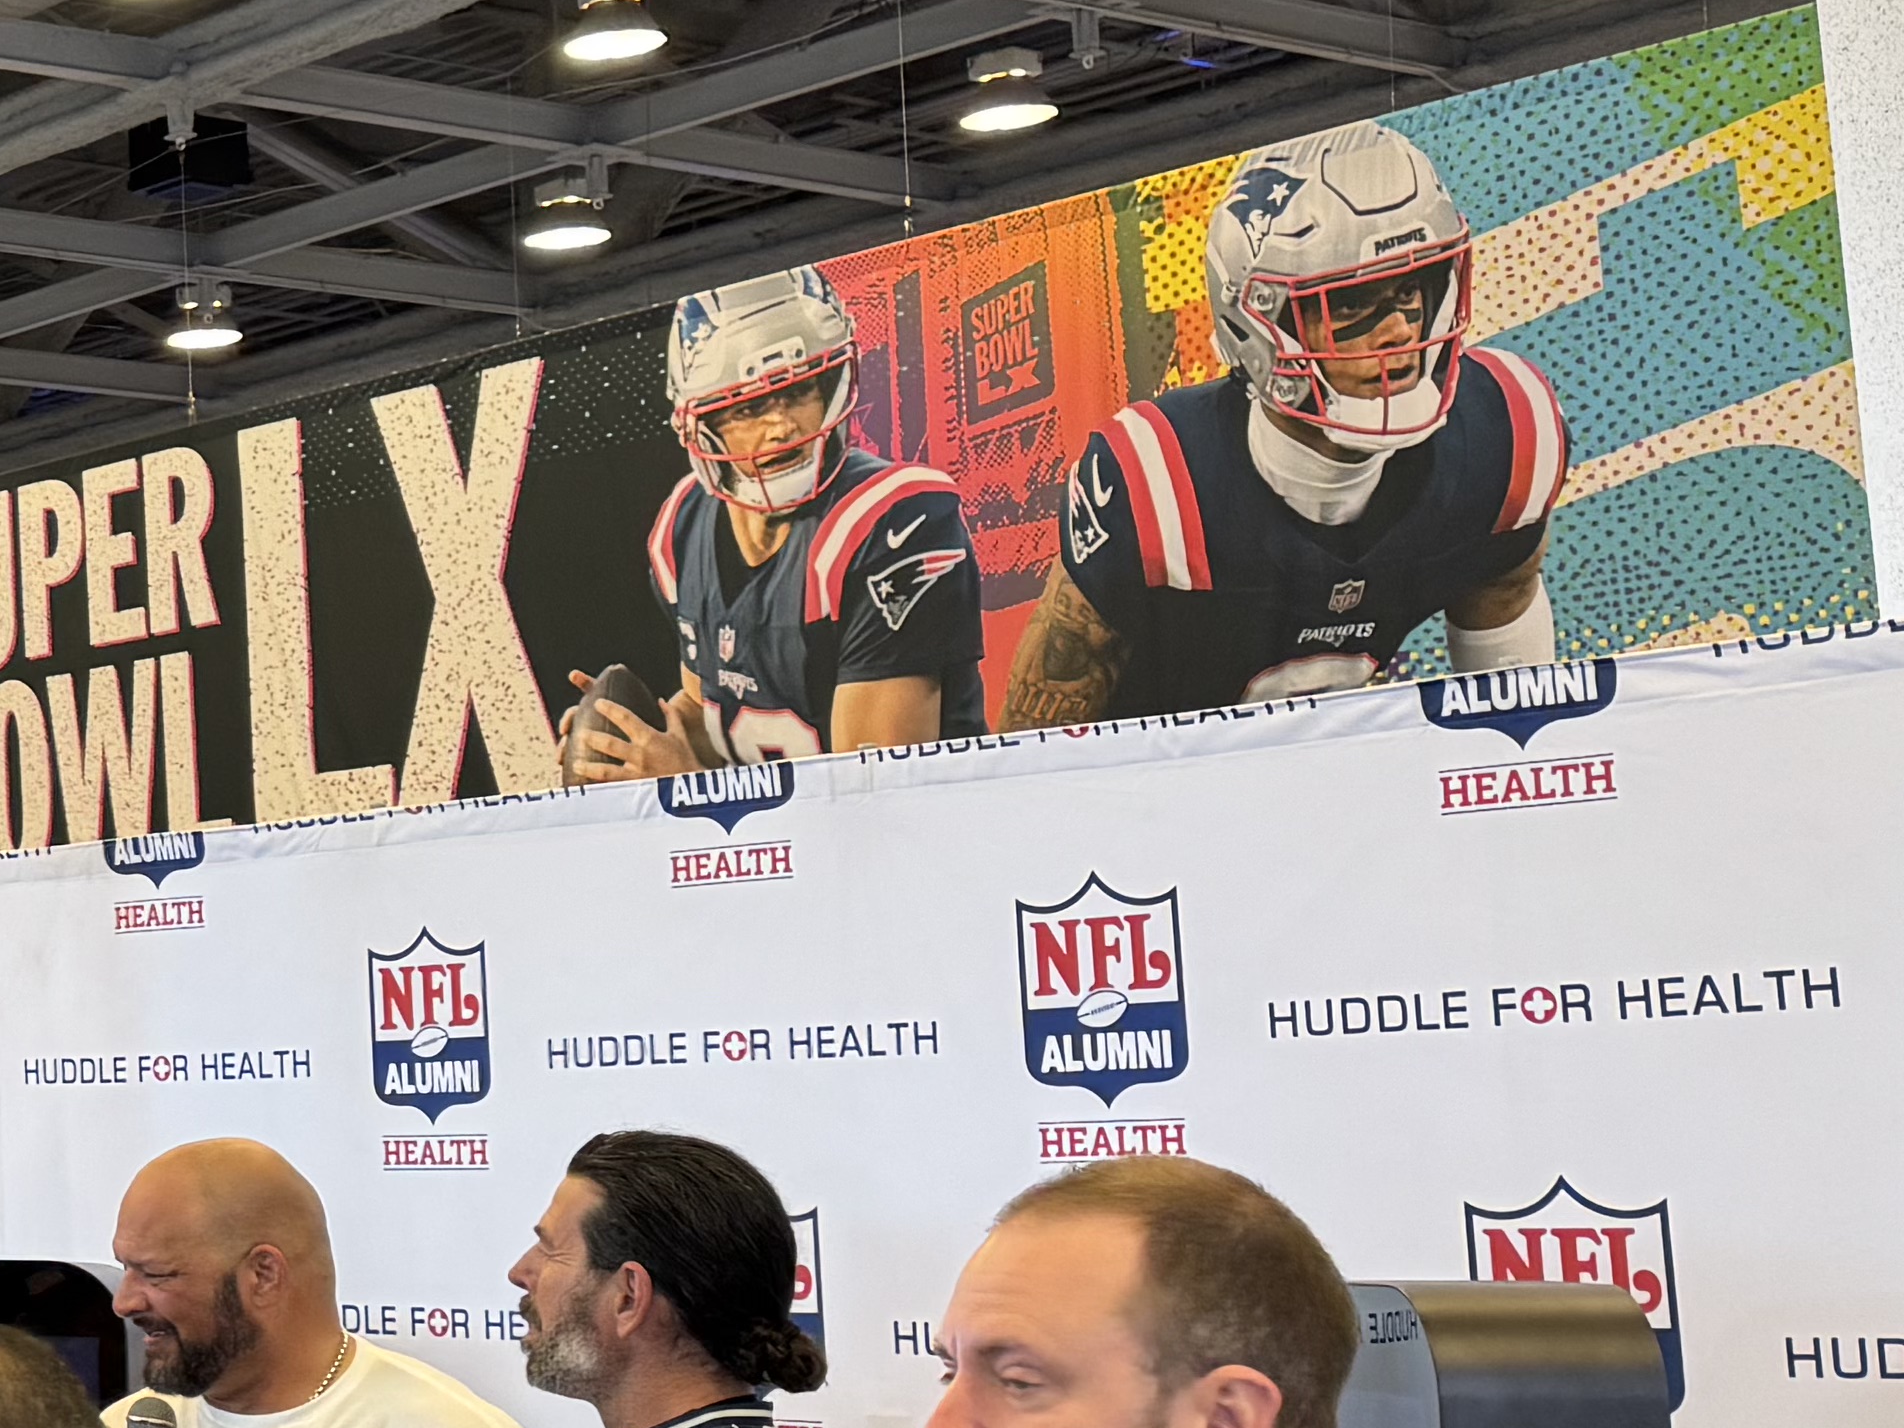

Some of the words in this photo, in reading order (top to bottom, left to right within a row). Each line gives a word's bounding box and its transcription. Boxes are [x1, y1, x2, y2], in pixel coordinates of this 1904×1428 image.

[971, 280, 1036, 341] SUPER
[975, 318, 1039, 379] BOWL
[977, 358, 1041, 406] LX
[237, 356, 565, 825] LX
[1440, 660, 1599, 718] ALUMNI
[671, 763, 784, 809] ALUMNI
[1440, 759, 1618, 810] HEALTH
[113, 831, 198, 866] ALUMNI
[670, 847, 794, 884] HEALTH
[114, 898, 206, 930] HEALTH
[1029, 912, 1172, 998] NFL
[376, 961, 481, 1033] NFL
[1268, 990, 1469, 1040] HUDDLE
[1492, 981, 1592, 1028] FOR
[1617, 966, 1842, 1021] HEALTH
[23, 1056, 128, 1086] HUDDLE
[139, 1054, 189, 1084] FOR
[201, 1049, 312, 1081] HEALTH
[548, 1030, 688, 1071] HUDDLE
[703, 1027, 772, 1063] FOR
[789, 1020, 940, 1061] HEALTH
[1041, 1028, 1174, 1074] ALUMNI
[384, 1059, 481, 1097] ALUMNI
[382, 1137, 490, 1169] HEALTH
[1039, 1123, 1188, 1159] HEALTH
[1482, 1226, 1663, 1314] NFL
[410, 1307, 470, 1339] FOR
